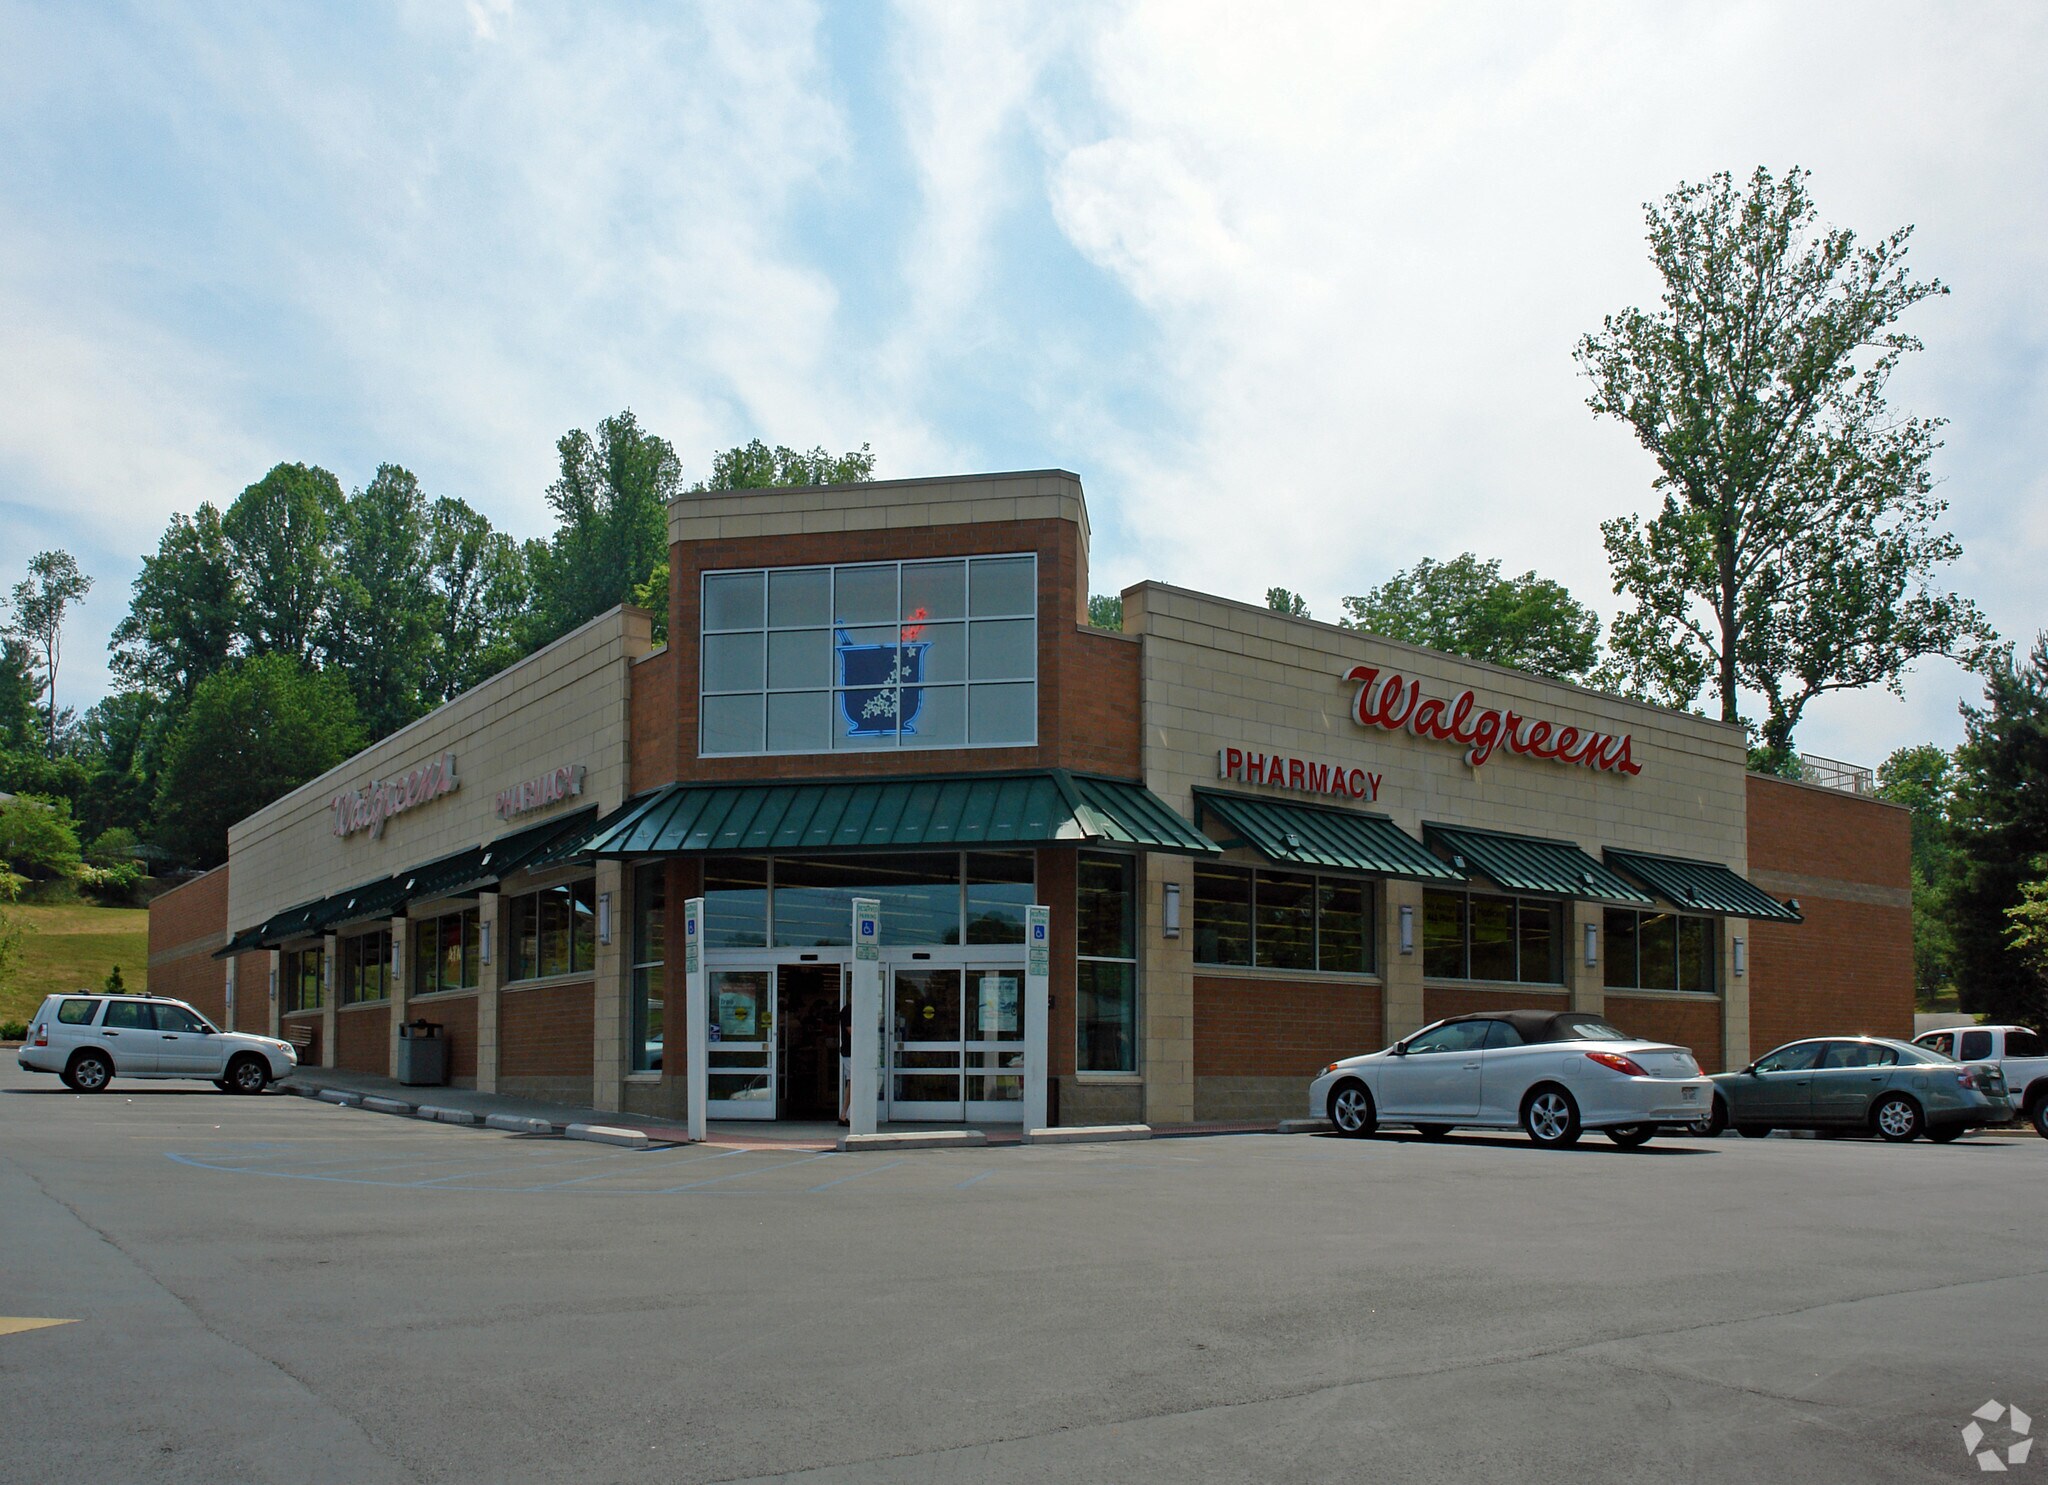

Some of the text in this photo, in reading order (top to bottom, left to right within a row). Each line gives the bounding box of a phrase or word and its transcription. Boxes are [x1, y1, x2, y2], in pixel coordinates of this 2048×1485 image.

[1342, 665, 1643, 777] Walgreens
[331, 751, 460, 840] Walgreens
[495, 764, 587, 821] PHARMACY
[1219, 747, 1383, 802] PHARMACY
